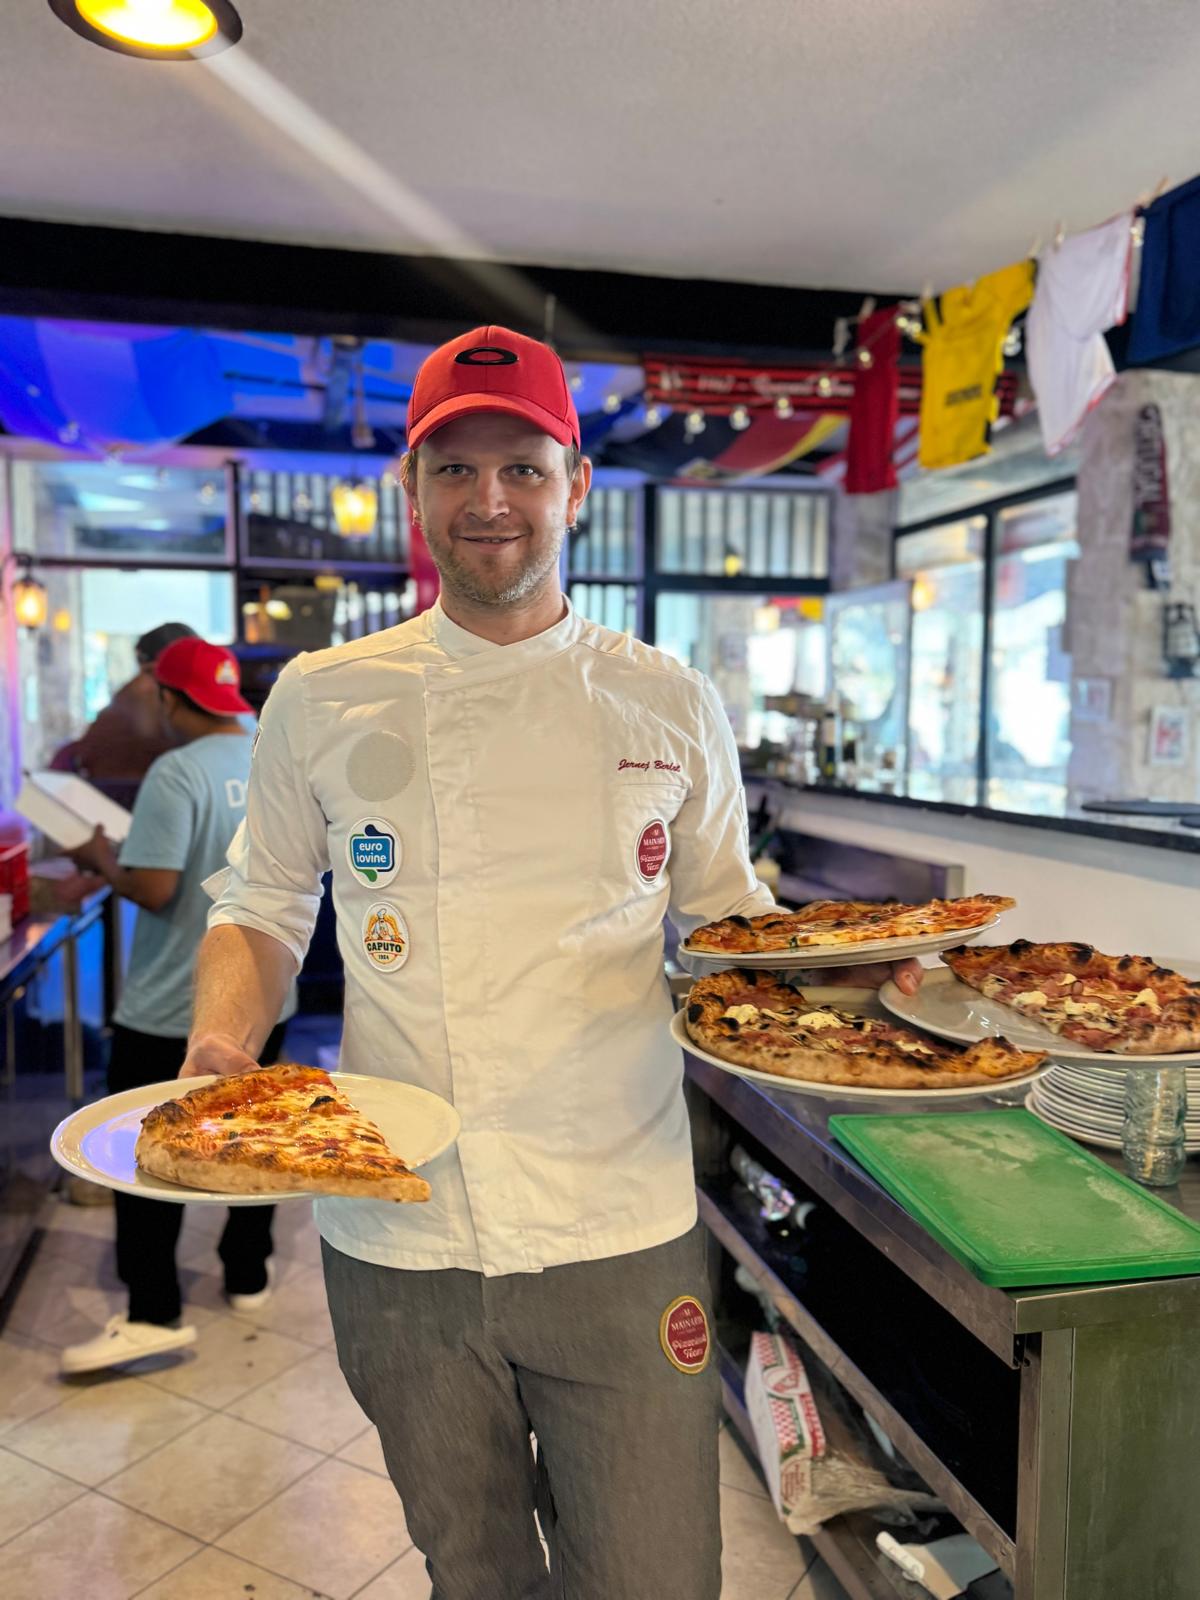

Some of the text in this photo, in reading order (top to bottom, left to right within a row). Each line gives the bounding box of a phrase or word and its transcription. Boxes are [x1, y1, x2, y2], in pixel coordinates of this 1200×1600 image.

[359, 842, 383, 851] euro
[356, 852, 387, 864] iovine
[367, 942, 402, 953] CAPUTO
